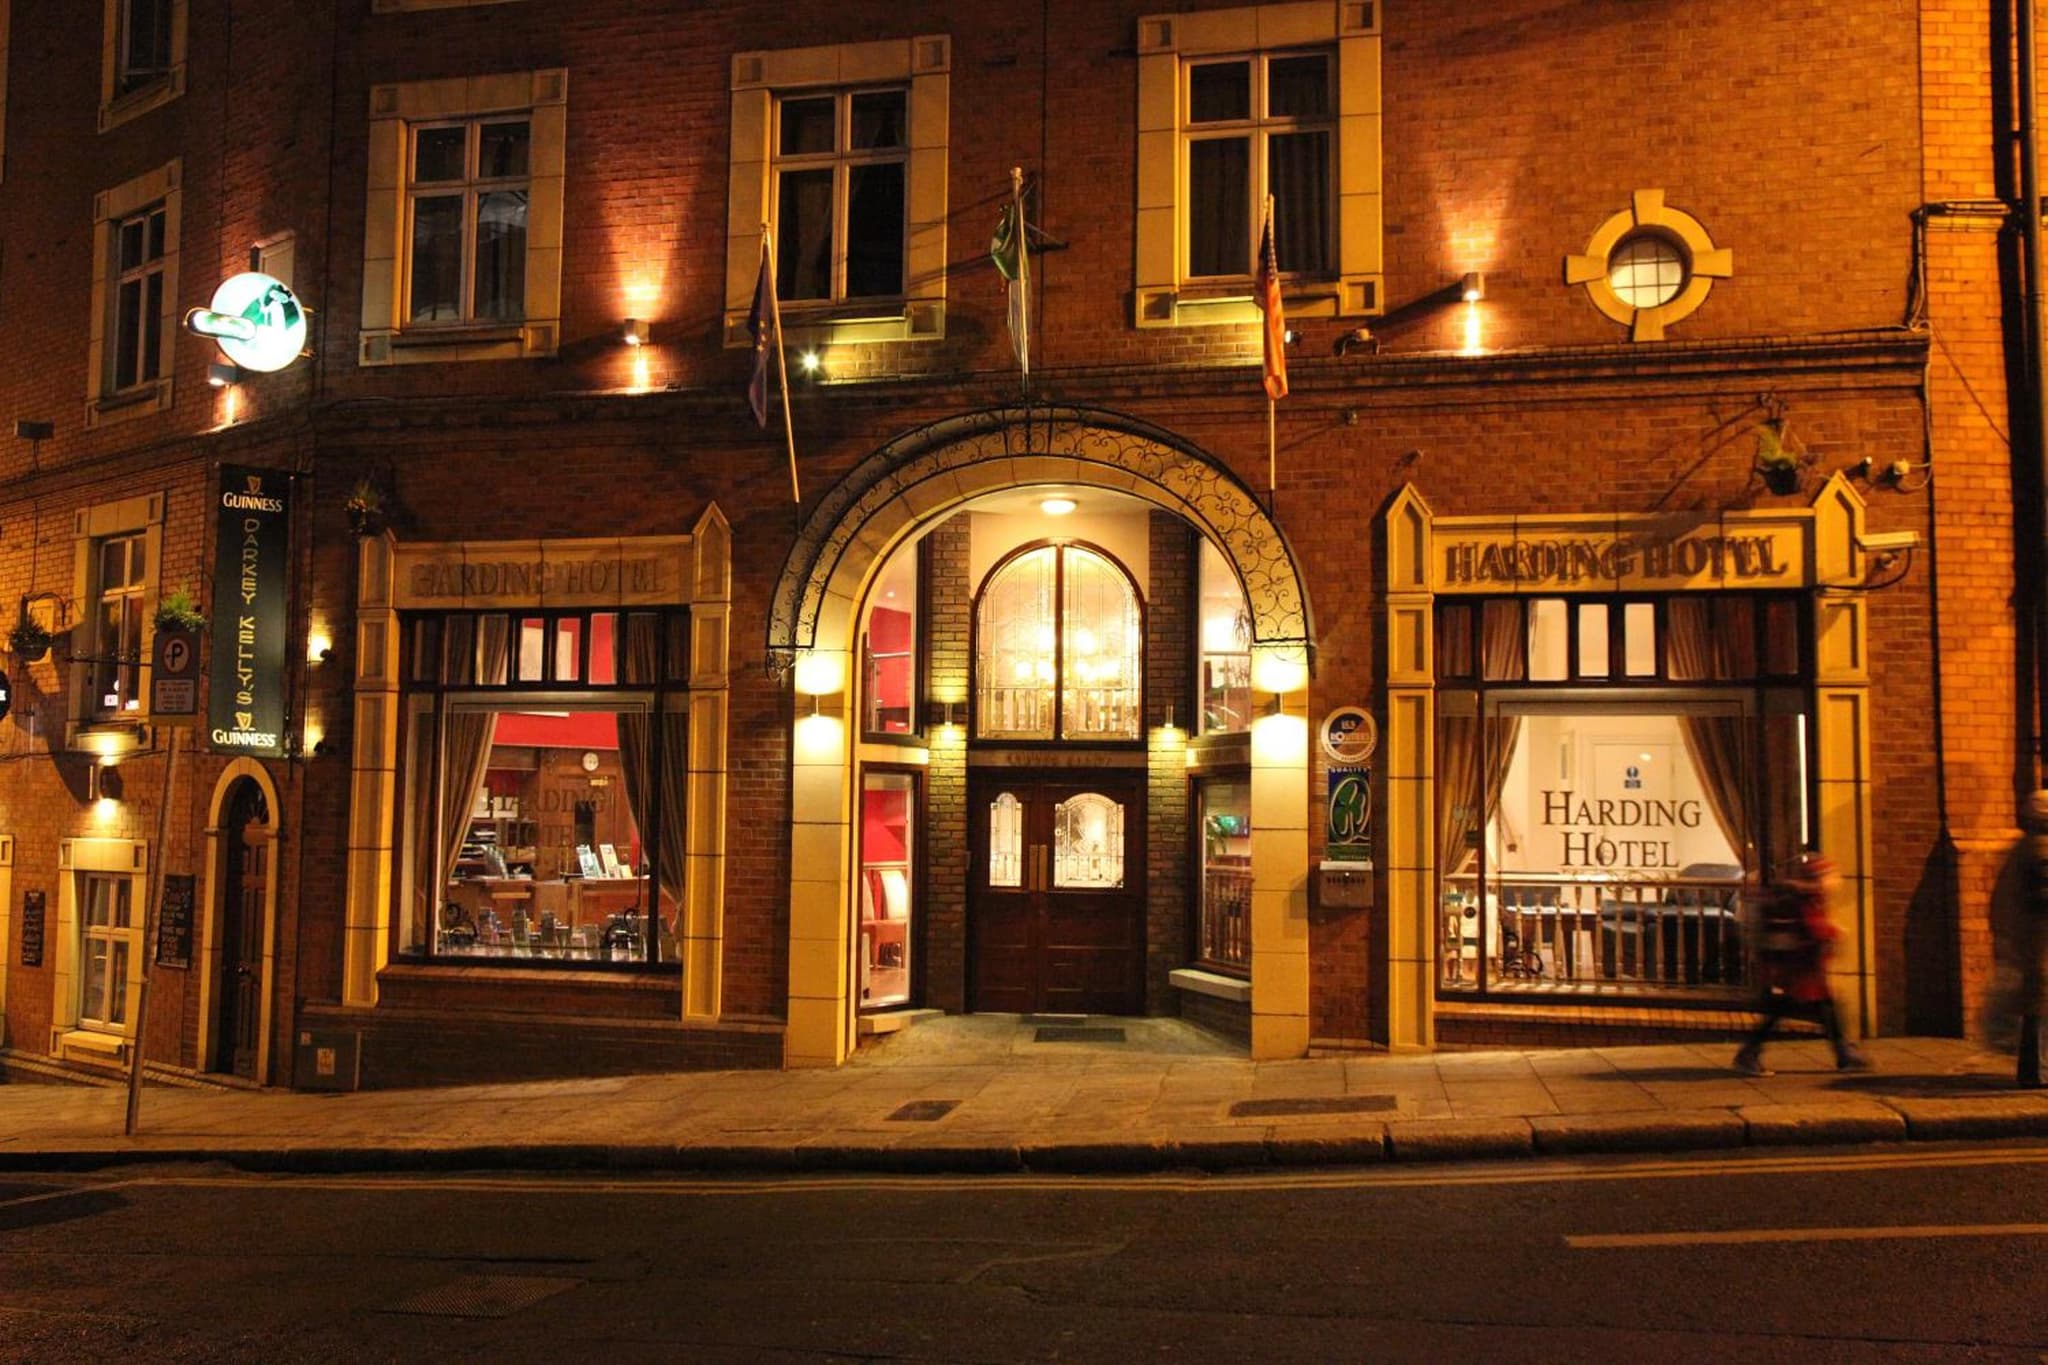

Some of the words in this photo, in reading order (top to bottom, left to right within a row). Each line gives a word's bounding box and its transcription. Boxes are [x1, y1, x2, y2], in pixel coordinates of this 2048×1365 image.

[223, 491, 283, 513] GUINNESS
[242, 518, 261, 605] DARKEY
[1447, 538, 1638, 582] HARDING
[1643, 534, 1788, 580] HOTEL
[411, 560, 555, 598] HARDING
[566, 557, 667, 595] HOTEL
[236, 616, 256, 706] KELLY'S
[212, 729, 277, 748] GUINNESS
[1541, 790, 1703, 827] HARDING
[501, 817, 586, 847] HOTE
[1560, 831, 1681, 868] HOTEL
